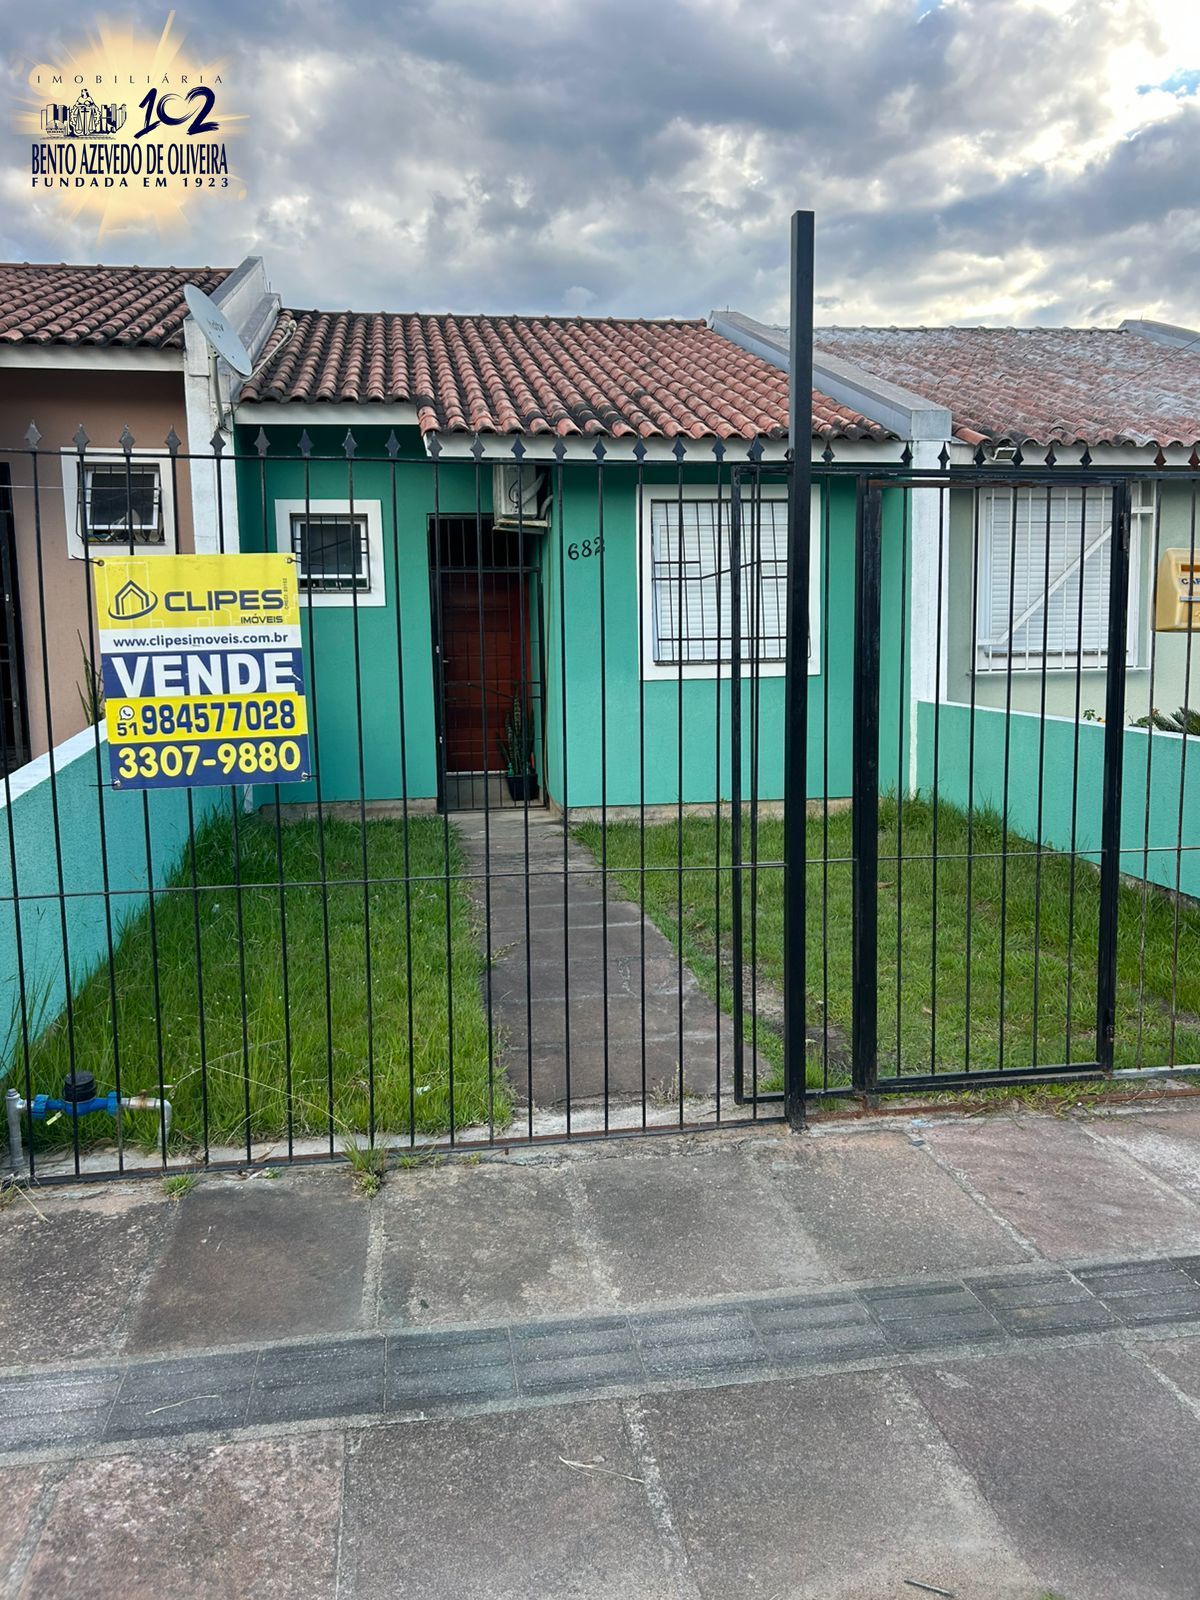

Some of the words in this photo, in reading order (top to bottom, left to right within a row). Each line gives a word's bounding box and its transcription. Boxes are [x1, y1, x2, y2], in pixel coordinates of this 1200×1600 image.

[567, 536, 606, 561] 682
[164, 589, 284, 612] CLIPES
[240, 613, 283, 624] IMÓVEIS
[113, 632, 288, 648] www.clipesimoveis.com.br
[111, 652, 296, 698] VENDE
[117, 722, 138, 736] 51
[141, 699, 296, 736] 984577028
[118, 740, 301, 779] 3307-9880
